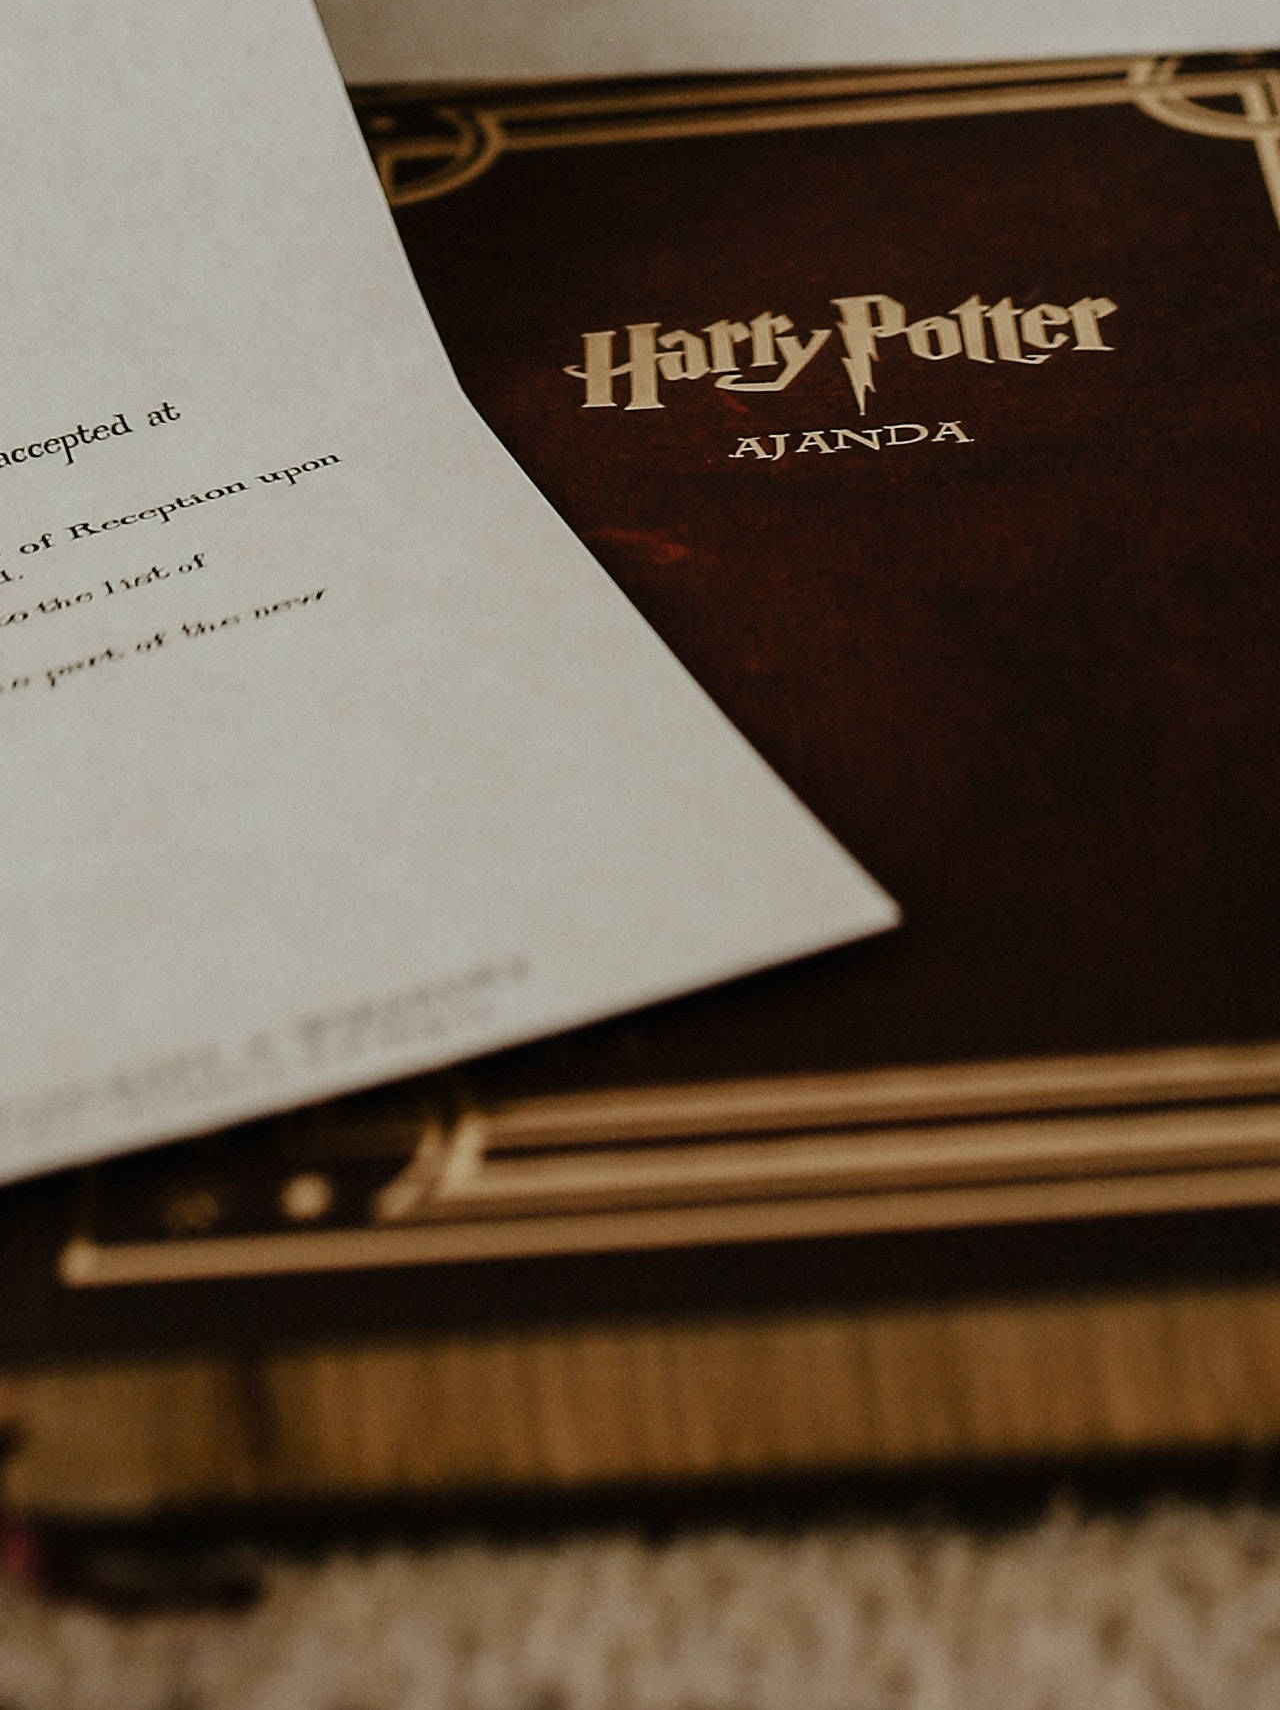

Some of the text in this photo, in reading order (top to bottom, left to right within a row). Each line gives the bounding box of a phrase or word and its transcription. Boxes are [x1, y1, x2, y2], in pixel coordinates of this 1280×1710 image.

[562, 293, 1120, 417] Harry Potter
[146, 401, 182, 428] at
[728, 420, 975, 462] AJANDA
